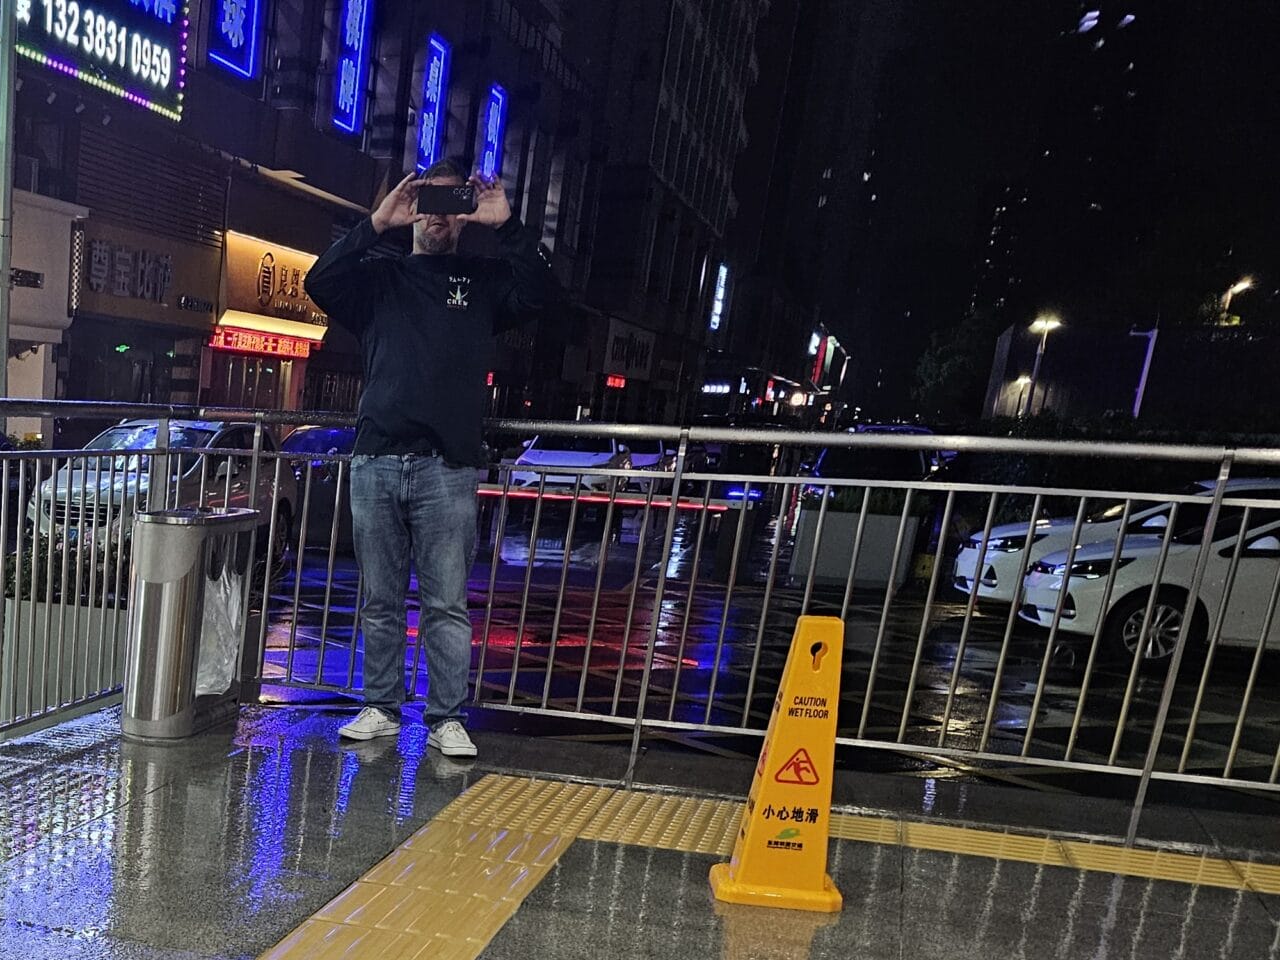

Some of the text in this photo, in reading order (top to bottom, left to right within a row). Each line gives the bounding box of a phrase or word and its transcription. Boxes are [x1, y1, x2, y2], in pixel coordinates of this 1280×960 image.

[43, 0, 80, 46] 132
[82, 9, 127, 68] 3831
[130, 33, 171, 88] 0959
[793, 696, 827, 708] CAUTION
[788, 707, 829, 719] WET FLOOR
[762, 804, 818, 824] 小心地滑
